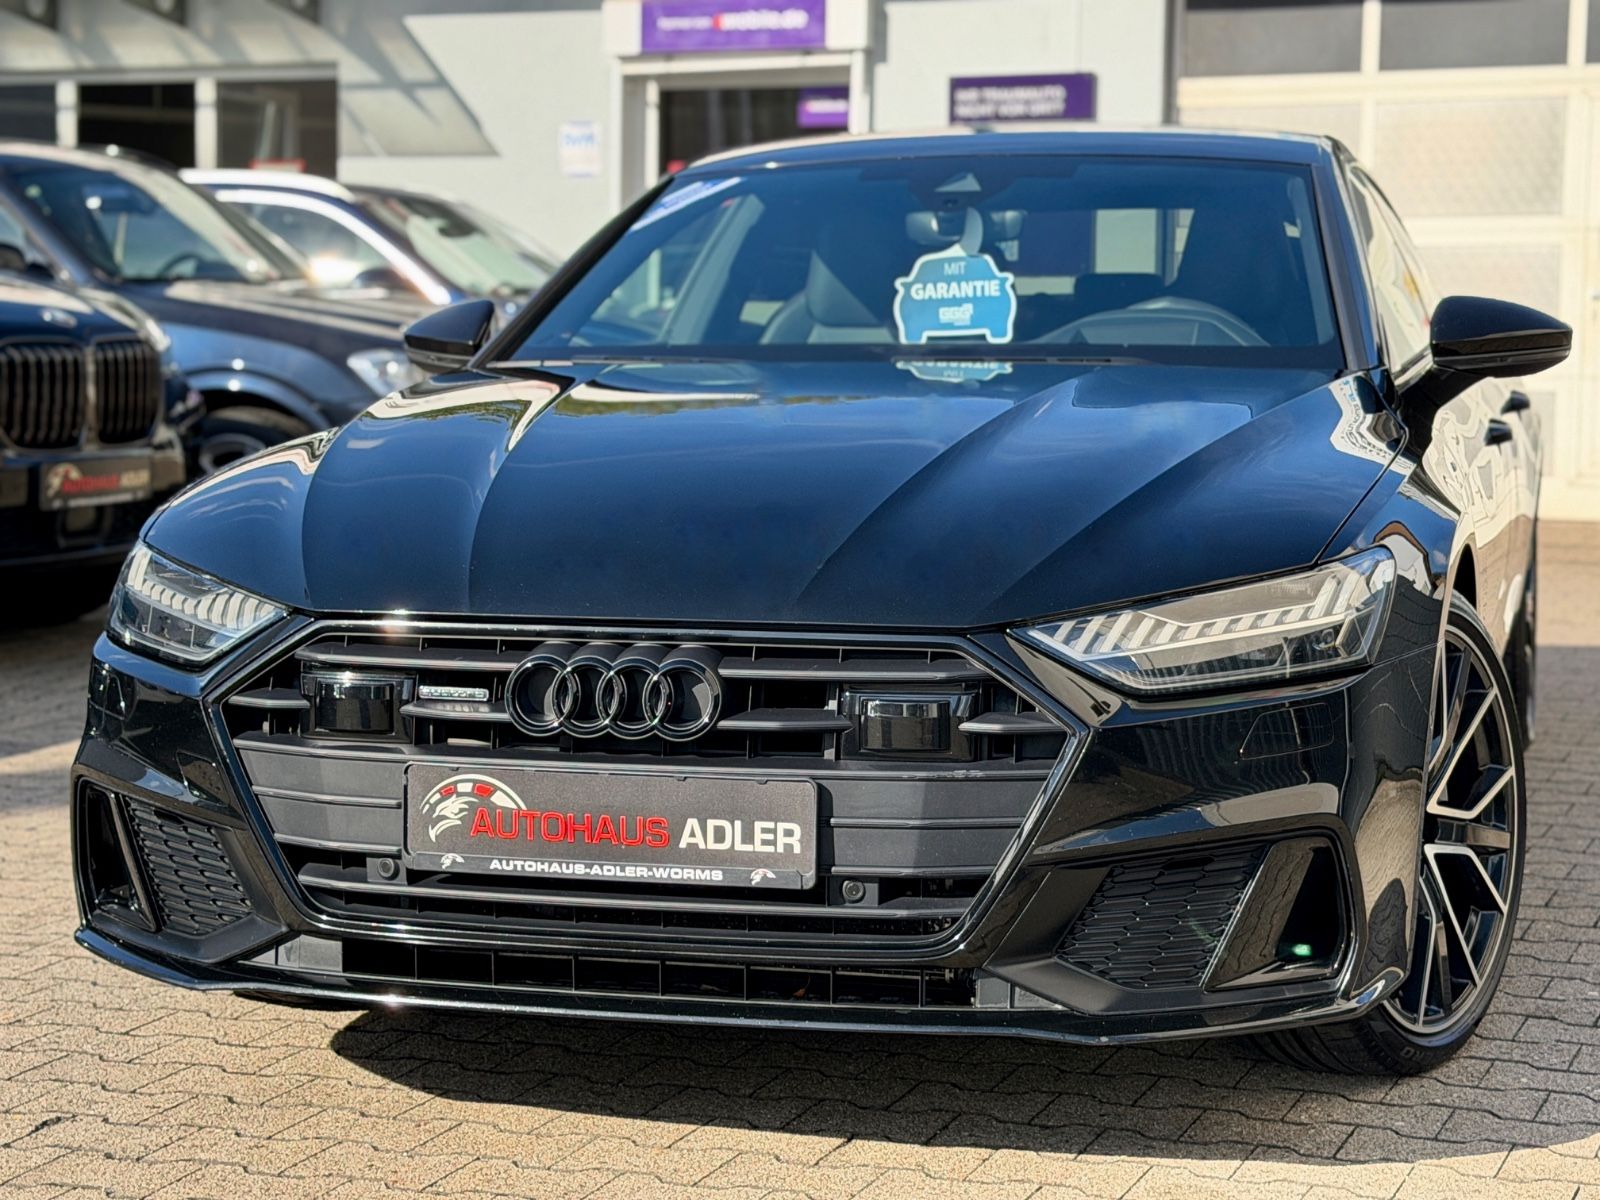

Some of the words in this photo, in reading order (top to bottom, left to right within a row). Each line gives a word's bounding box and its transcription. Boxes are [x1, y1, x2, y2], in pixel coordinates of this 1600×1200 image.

[943, 261, 966, 275] MIT
[911, 280, 1000, 300] GARANTIE
[470, 807, 670, 848] AUTOHAUS
[678, 818, 801, 854] ADLER
[489, 858, 724, 881] AUTOHAUS-ADLER-WORMS
